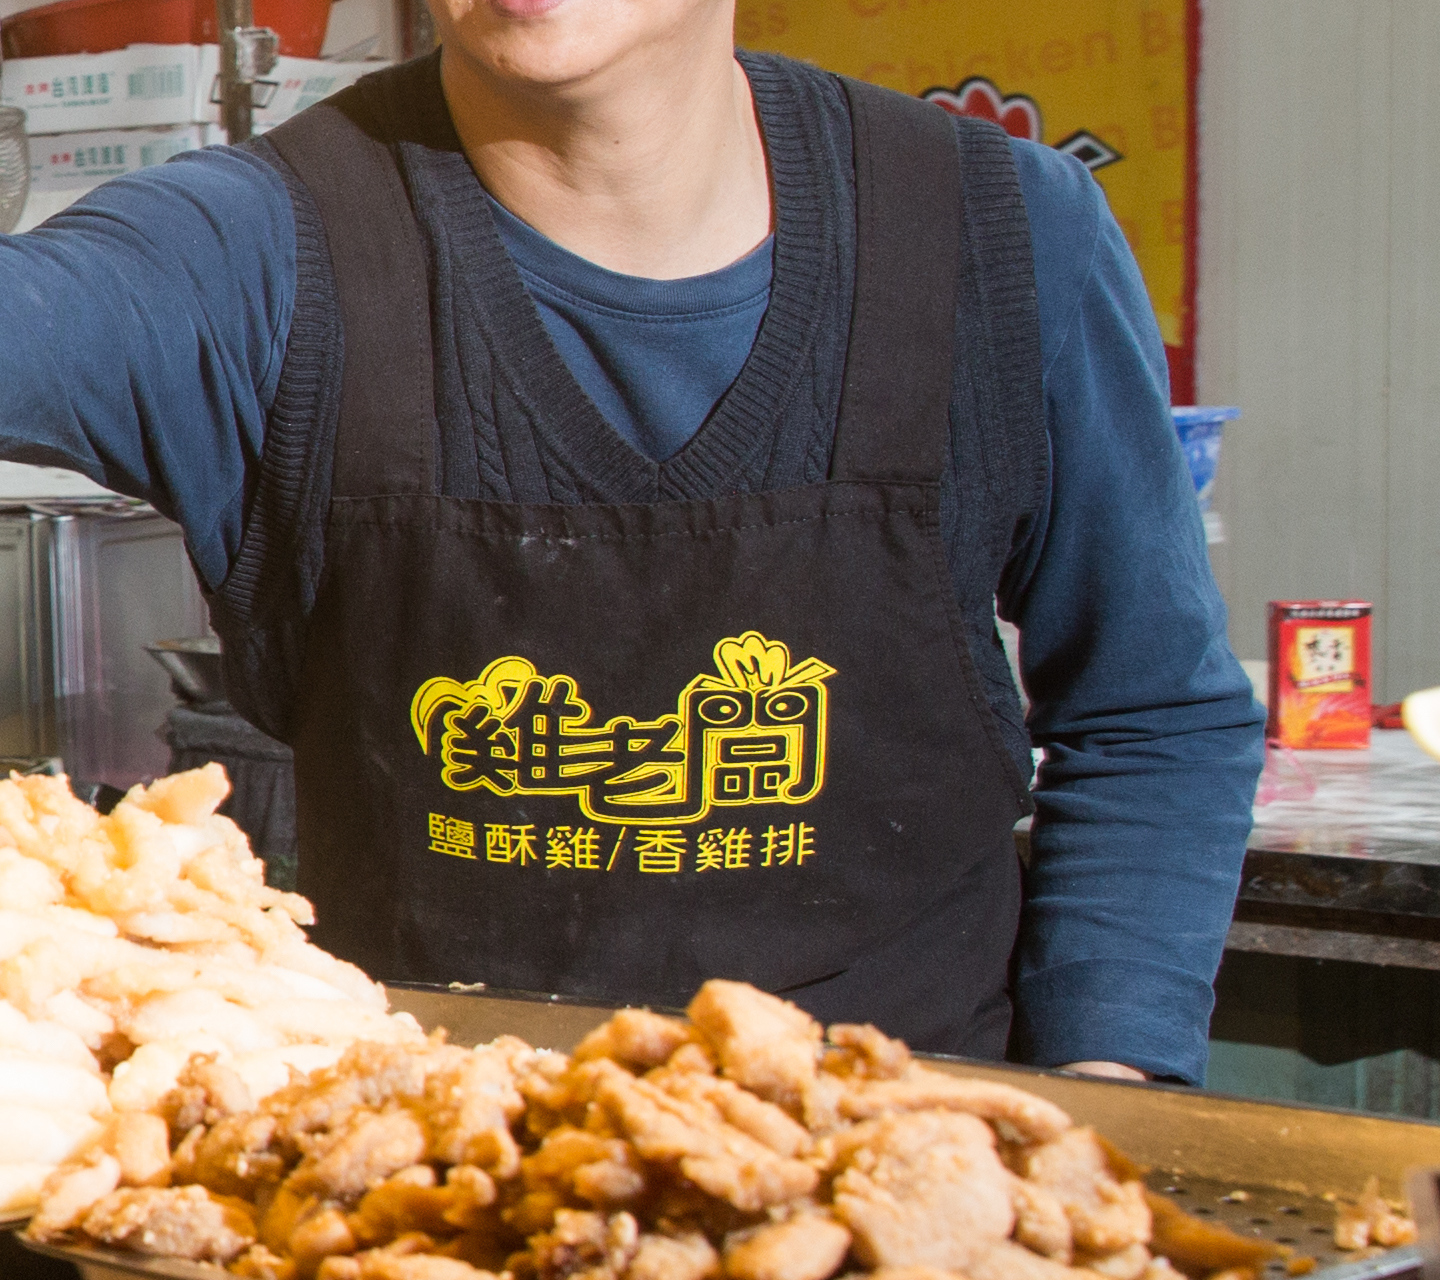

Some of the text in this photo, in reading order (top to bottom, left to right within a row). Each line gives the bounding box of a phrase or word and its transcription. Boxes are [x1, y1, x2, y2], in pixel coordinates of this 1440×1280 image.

[428, 812, 817, 874] 鹽酥雞/香雞排
